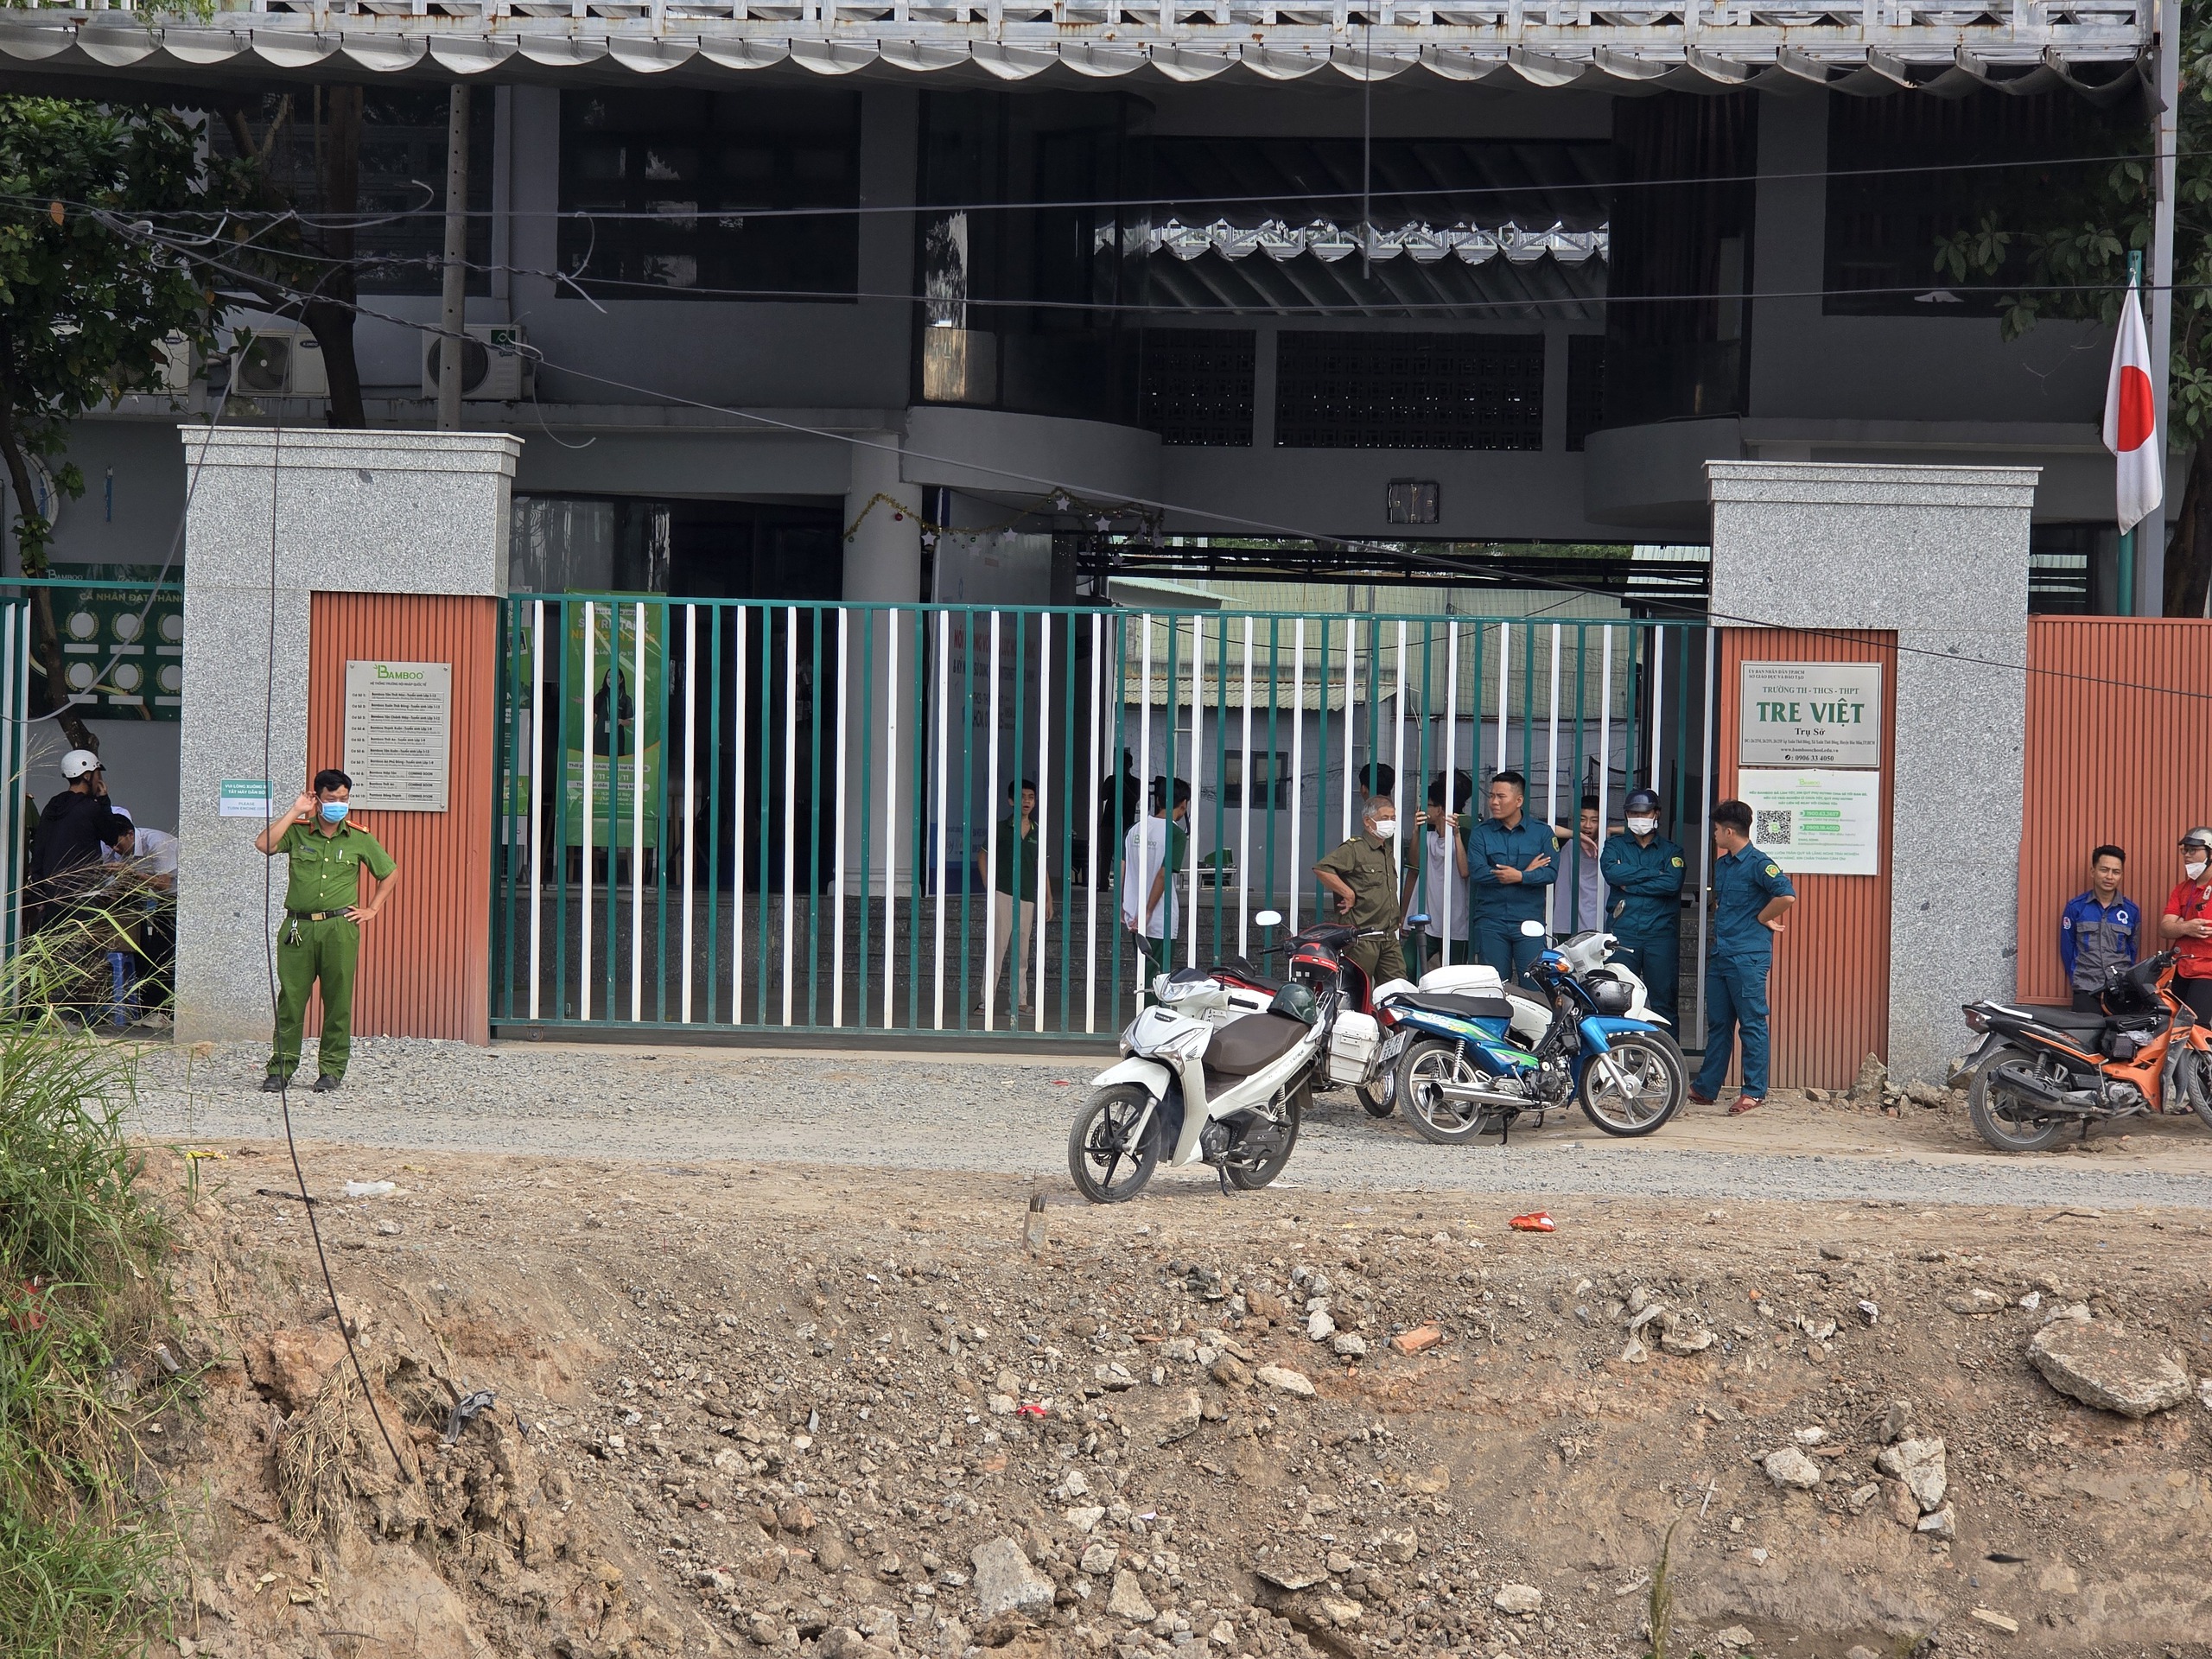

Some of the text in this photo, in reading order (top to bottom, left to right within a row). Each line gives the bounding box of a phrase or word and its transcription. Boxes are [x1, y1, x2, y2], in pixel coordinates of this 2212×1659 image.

[153, 592, 183, 602] THÀN
[375, 664, 423, 679] BAMBOO
[1763, 685, 1794, 693] TRƯỜNG
[1756, 698, 1865, 727] TRE VIỆT
[1794, 728, 1810, 737] Trụ
